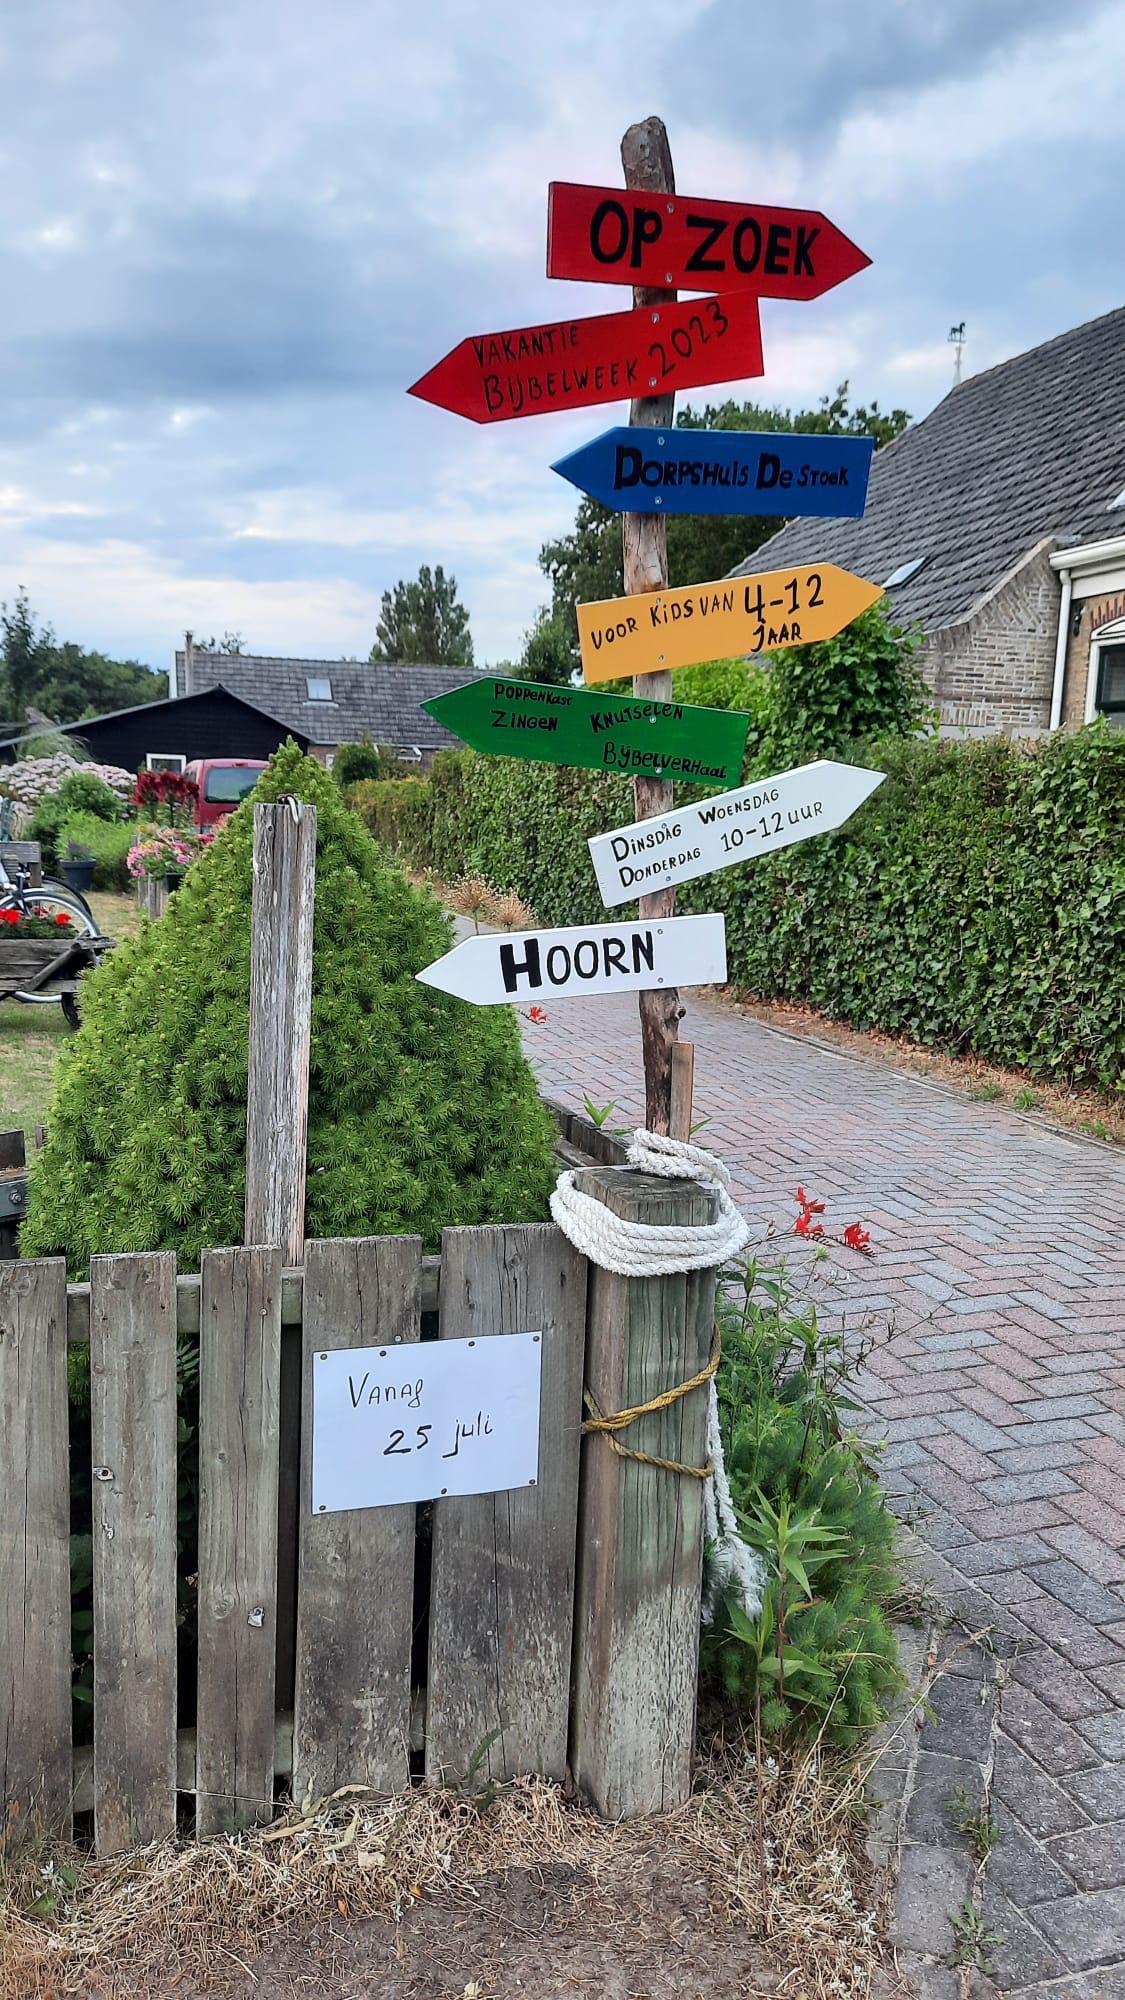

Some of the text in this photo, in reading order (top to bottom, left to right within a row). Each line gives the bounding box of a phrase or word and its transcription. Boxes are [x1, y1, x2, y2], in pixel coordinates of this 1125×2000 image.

[590, 199, 820, 277] OP ZOEK
[649, 301, 728, 378] 2023
[590, 617, 639, 650] VOOR
[700, 590, 734, 617] VAN
[744, 574, 825, 622] 4-12
[697, 788, 780, 825] WOENSDAG
[619, 846, 701, 888] DONDERDAG
[719, 812, 785, 854] 10-12
[500, 930, 654, 993] HOORN
[383, 1411, 493, 1459] 25 juli
